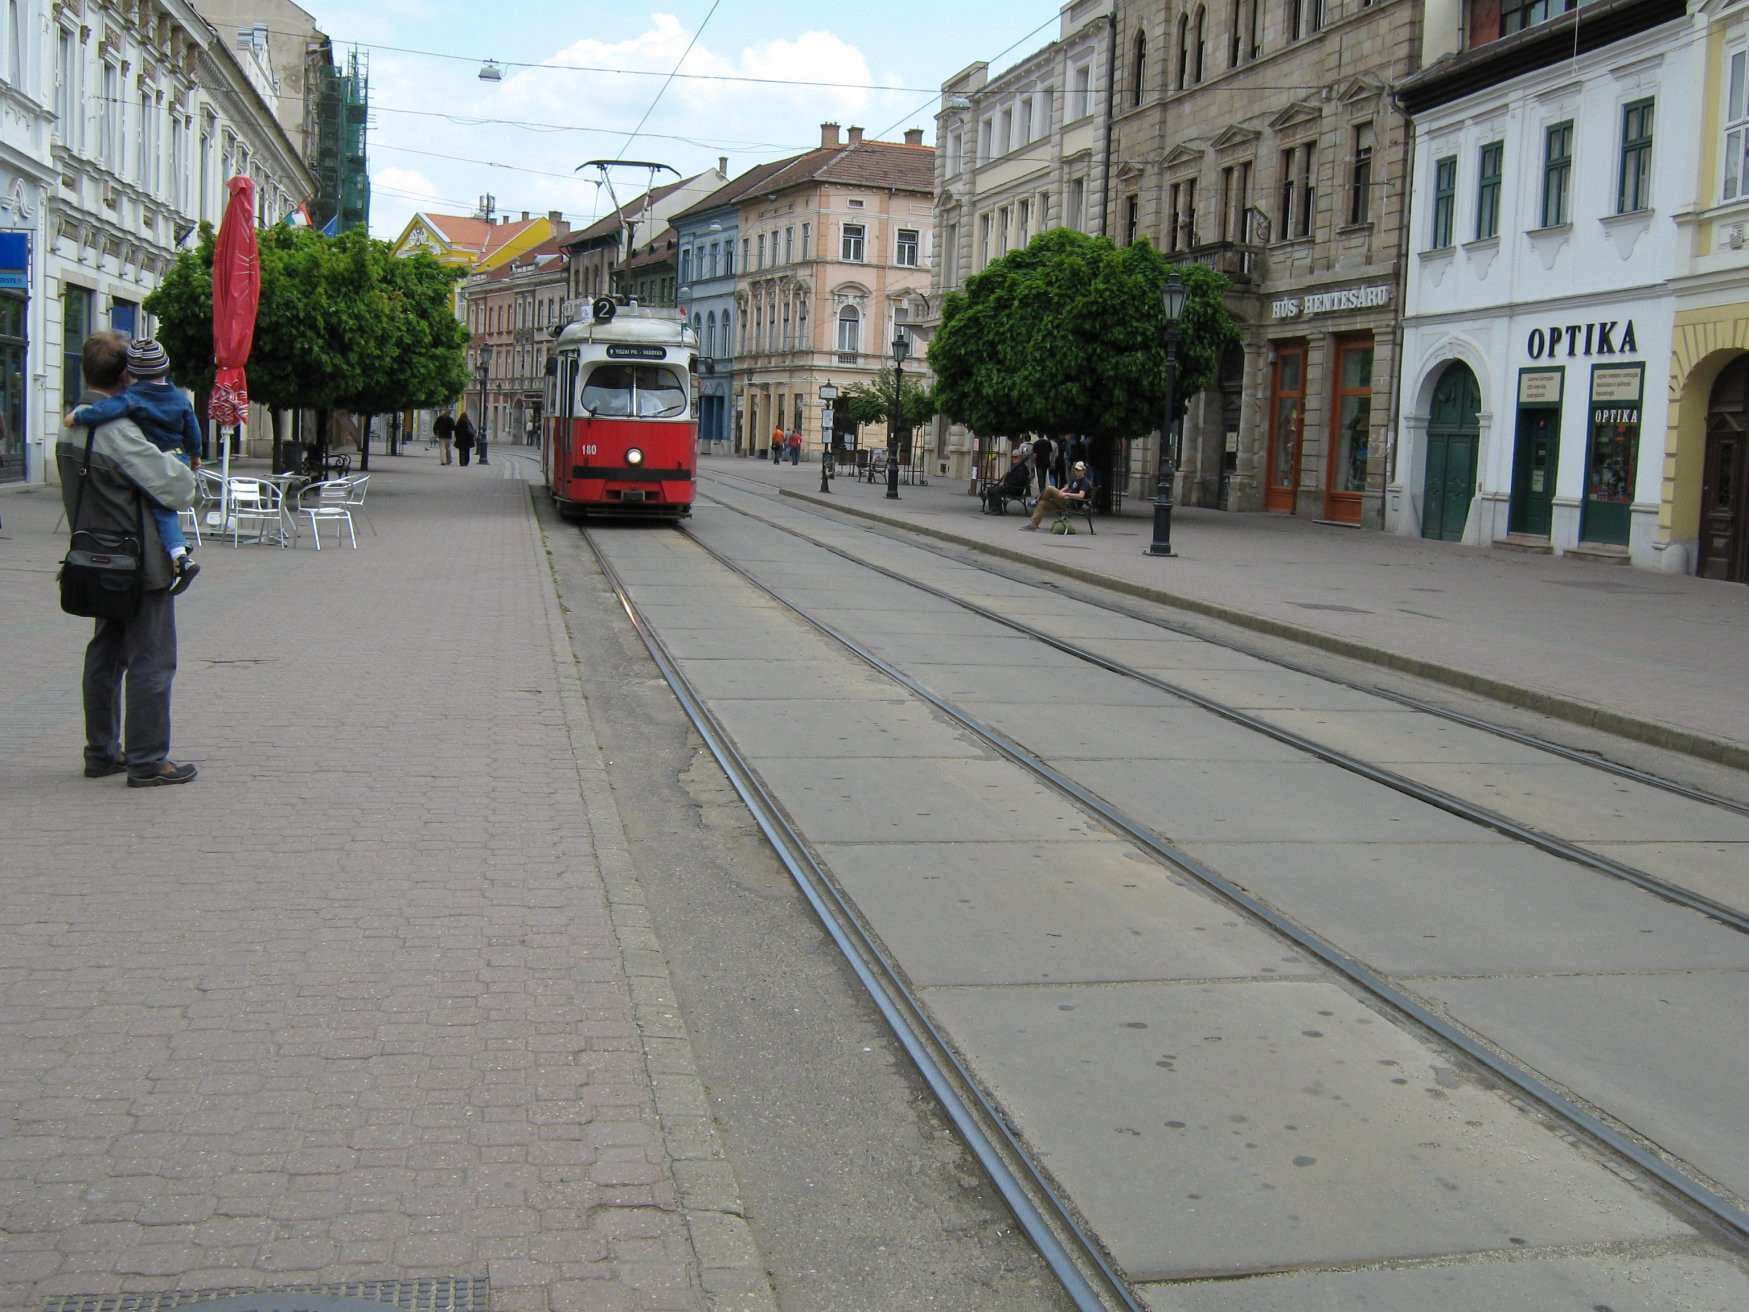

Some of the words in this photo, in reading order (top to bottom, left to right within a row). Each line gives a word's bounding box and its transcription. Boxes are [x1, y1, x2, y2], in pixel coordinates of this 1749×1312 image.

[598, 301, 610, 318] 2
[1271, 297, 1298, 319] HÚS
[1303, 285, 1389, 314] HENTESÁRU
[1527, 319, 1638, 359] OPTIKA
[1595, 409, 1638, 423] OPTIKA
[582, 444, 597, 455] 180
